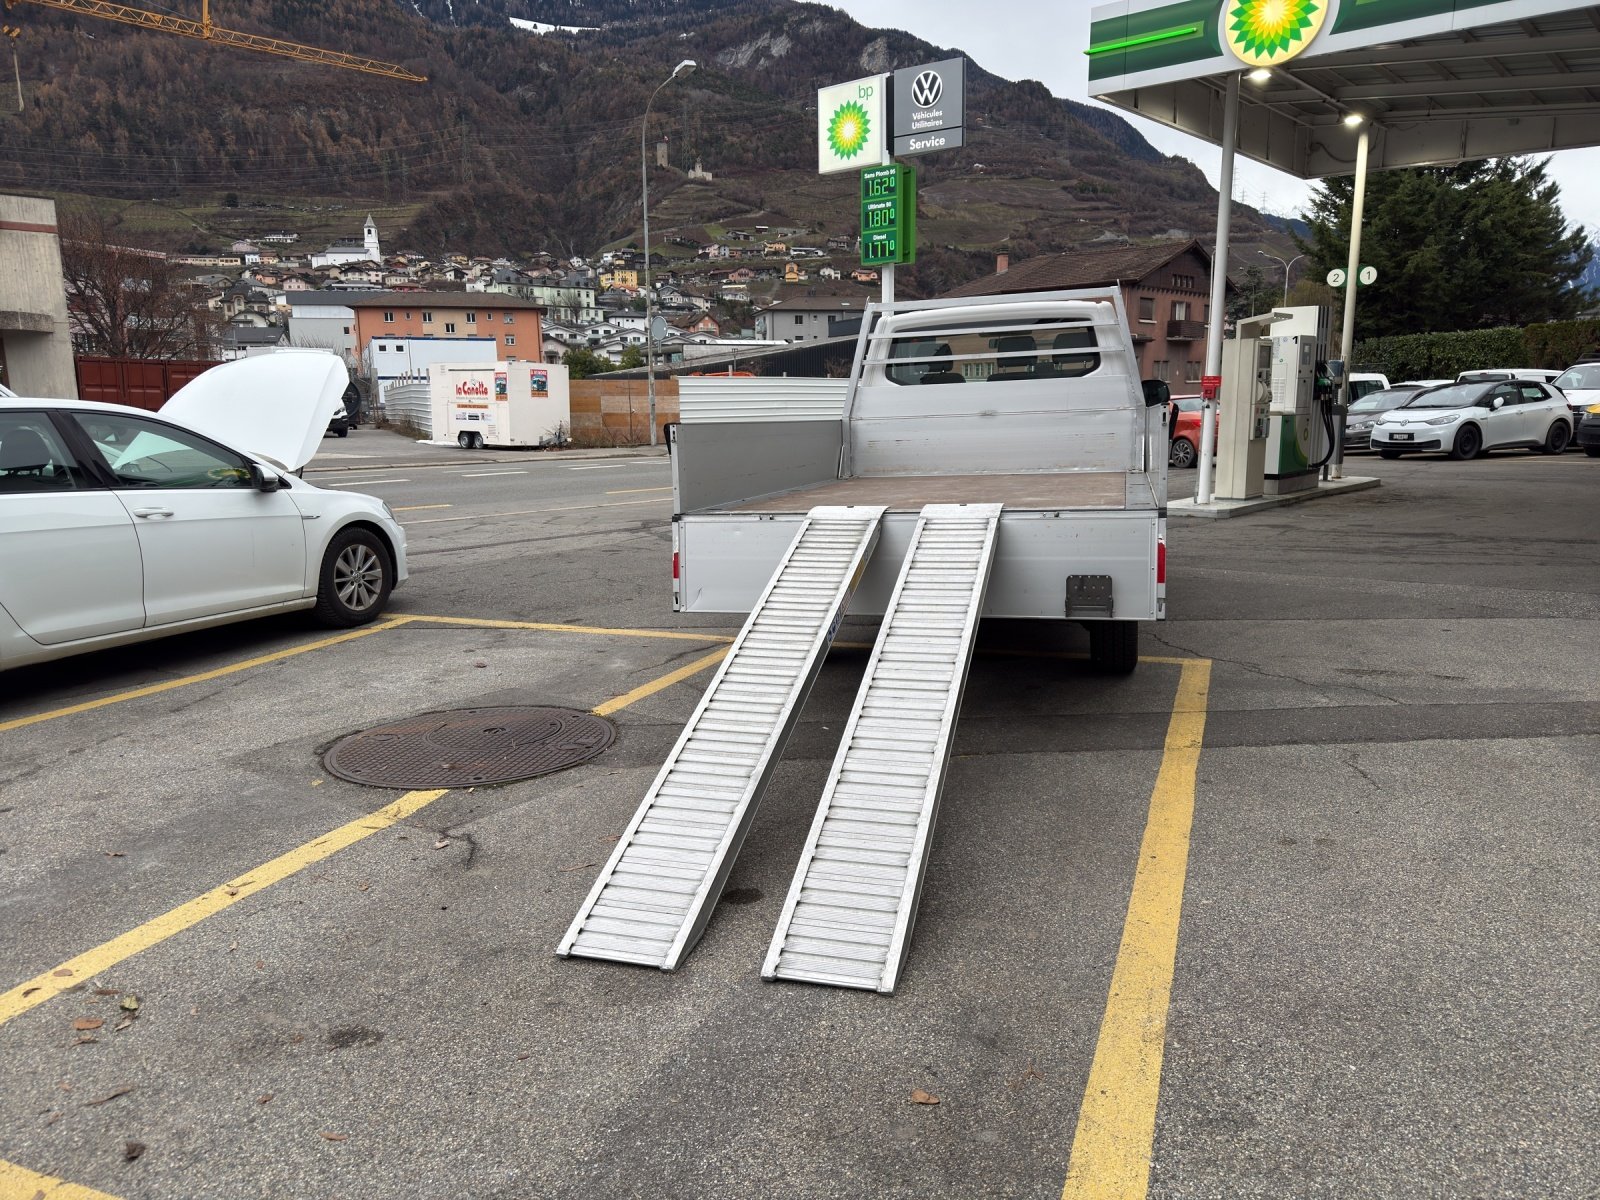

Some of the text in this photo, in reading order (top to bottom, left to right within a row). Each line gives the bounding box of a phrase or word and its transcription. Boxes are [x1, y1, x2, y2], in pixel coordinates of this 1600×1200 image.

[858, 85, 873, 100] bp
[912, 109, 943, 121] Véhicules
[911, 119, 943, 130] Utilitaires
[909, 136, 946, 150] Service
[1332, 273, 1340, 283] 2
[1366, 270, 1371, 280] 1
[1292, 336, 1298, 344] 1
[456, 382, 488, 396] la Canette
